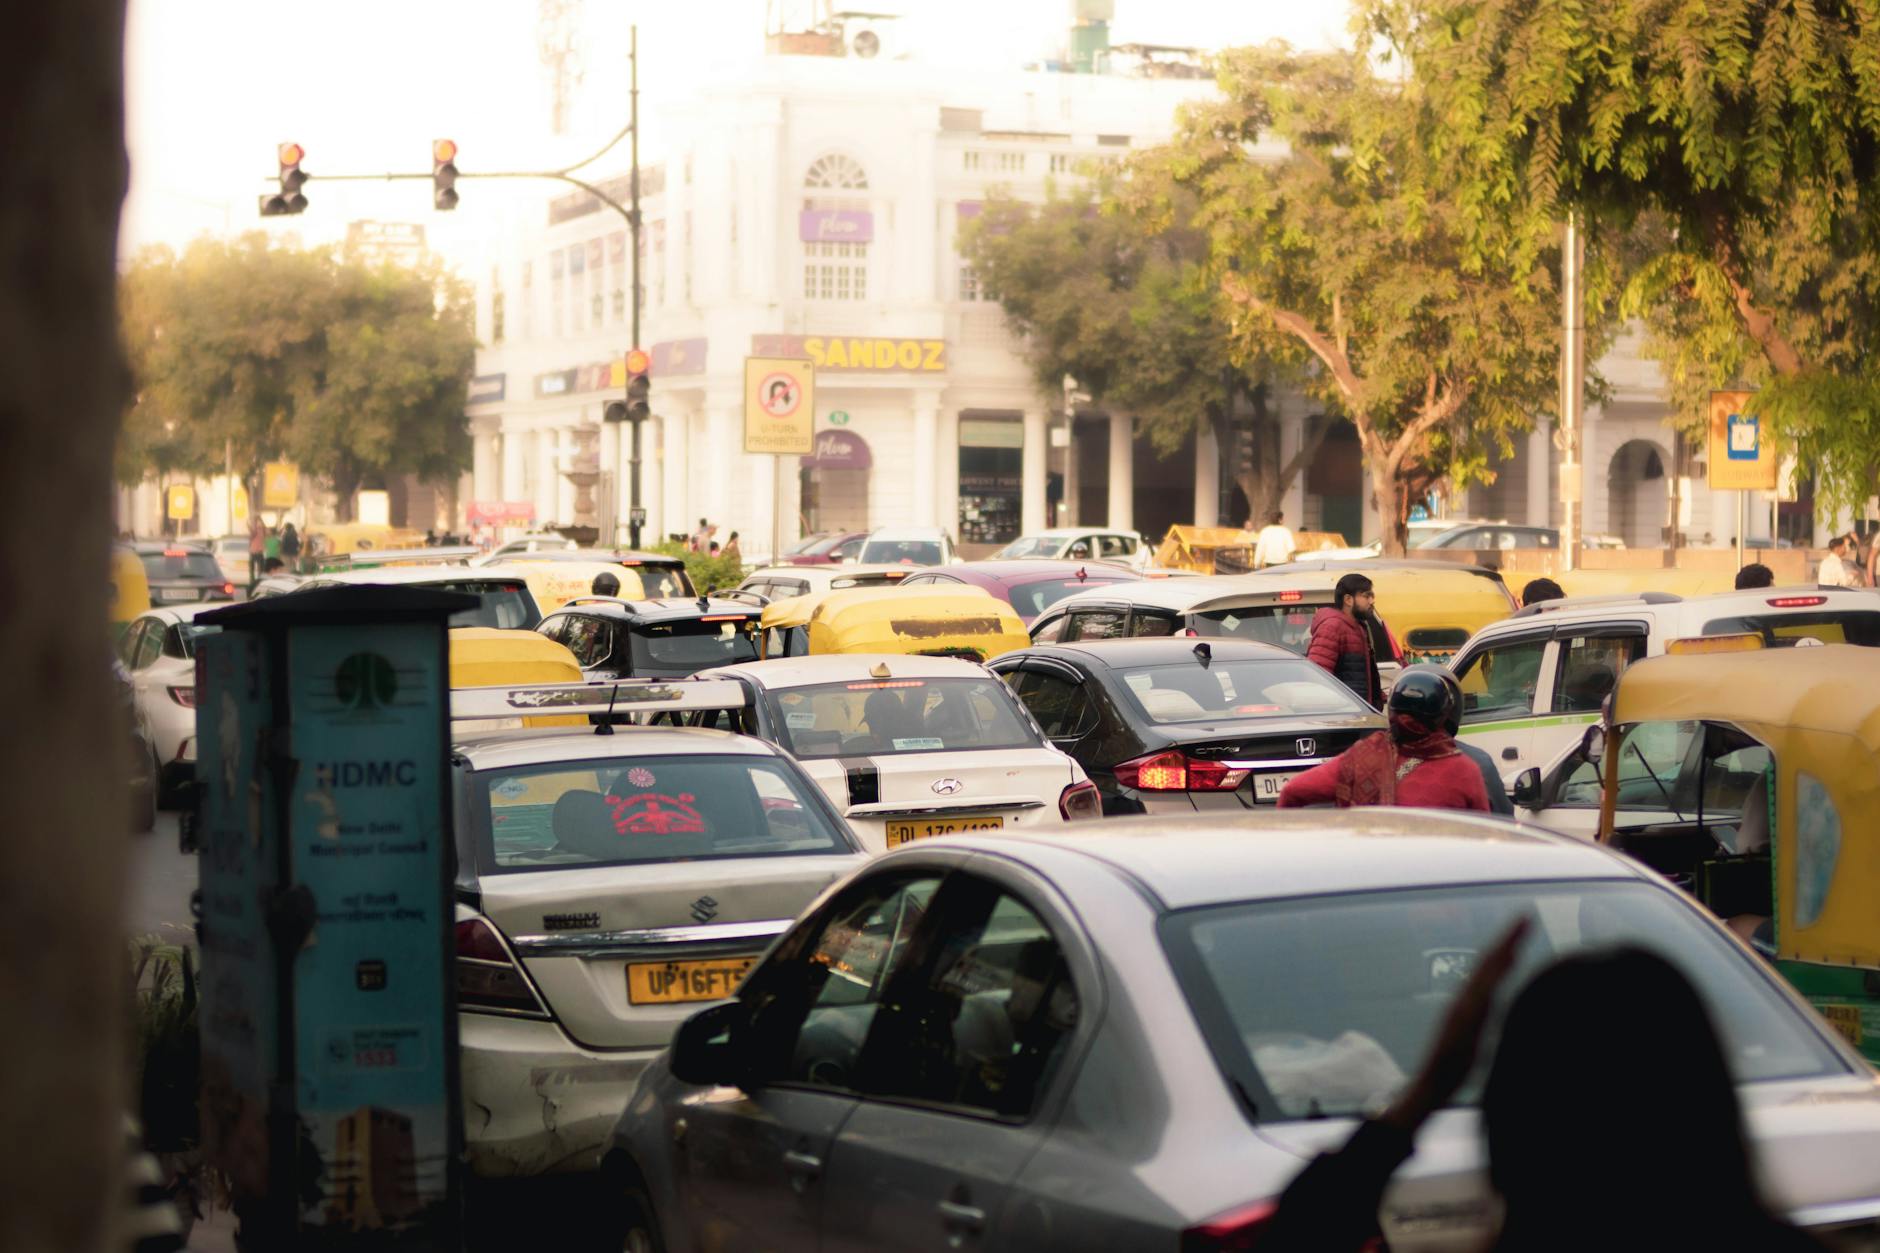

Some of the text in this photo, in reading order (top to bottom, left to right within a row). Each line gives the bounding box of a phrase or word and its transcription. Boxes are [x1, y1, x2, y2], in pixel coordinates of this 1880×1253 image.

[804, 338, 944, 370] SANDOZ
[760, 424, 799, 434] U-TURN
[747, 435, 810, 447] PROHIBITED
[316, 759, 417, 788] NDMC
